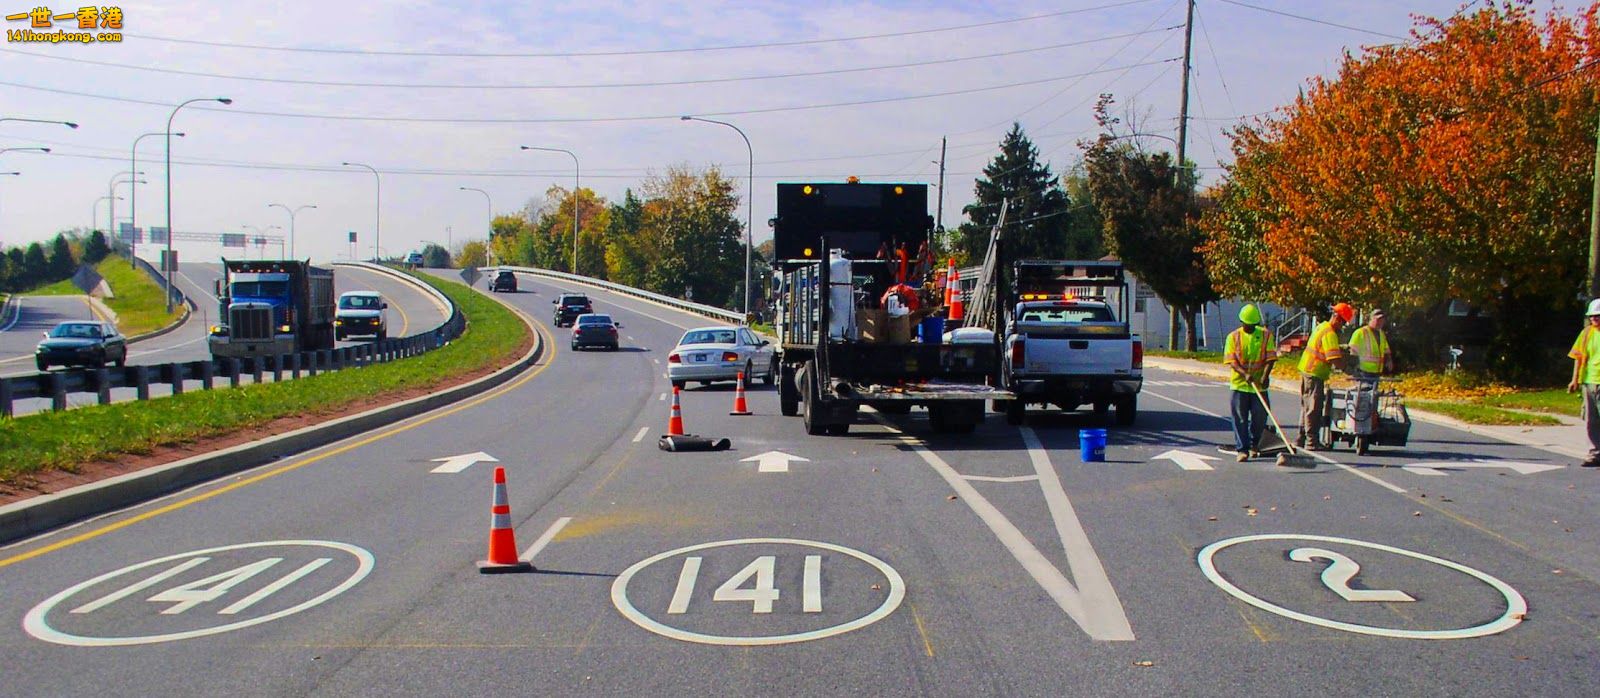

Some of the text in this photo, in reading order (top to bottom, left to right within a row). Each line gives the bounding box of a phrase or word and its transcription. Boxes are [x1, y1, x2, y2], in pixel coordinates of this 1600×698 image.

[70, 557, 333, 614] 141
[668, 555, 822, 613] 141
[1290, 548, 1415, 602] 2
